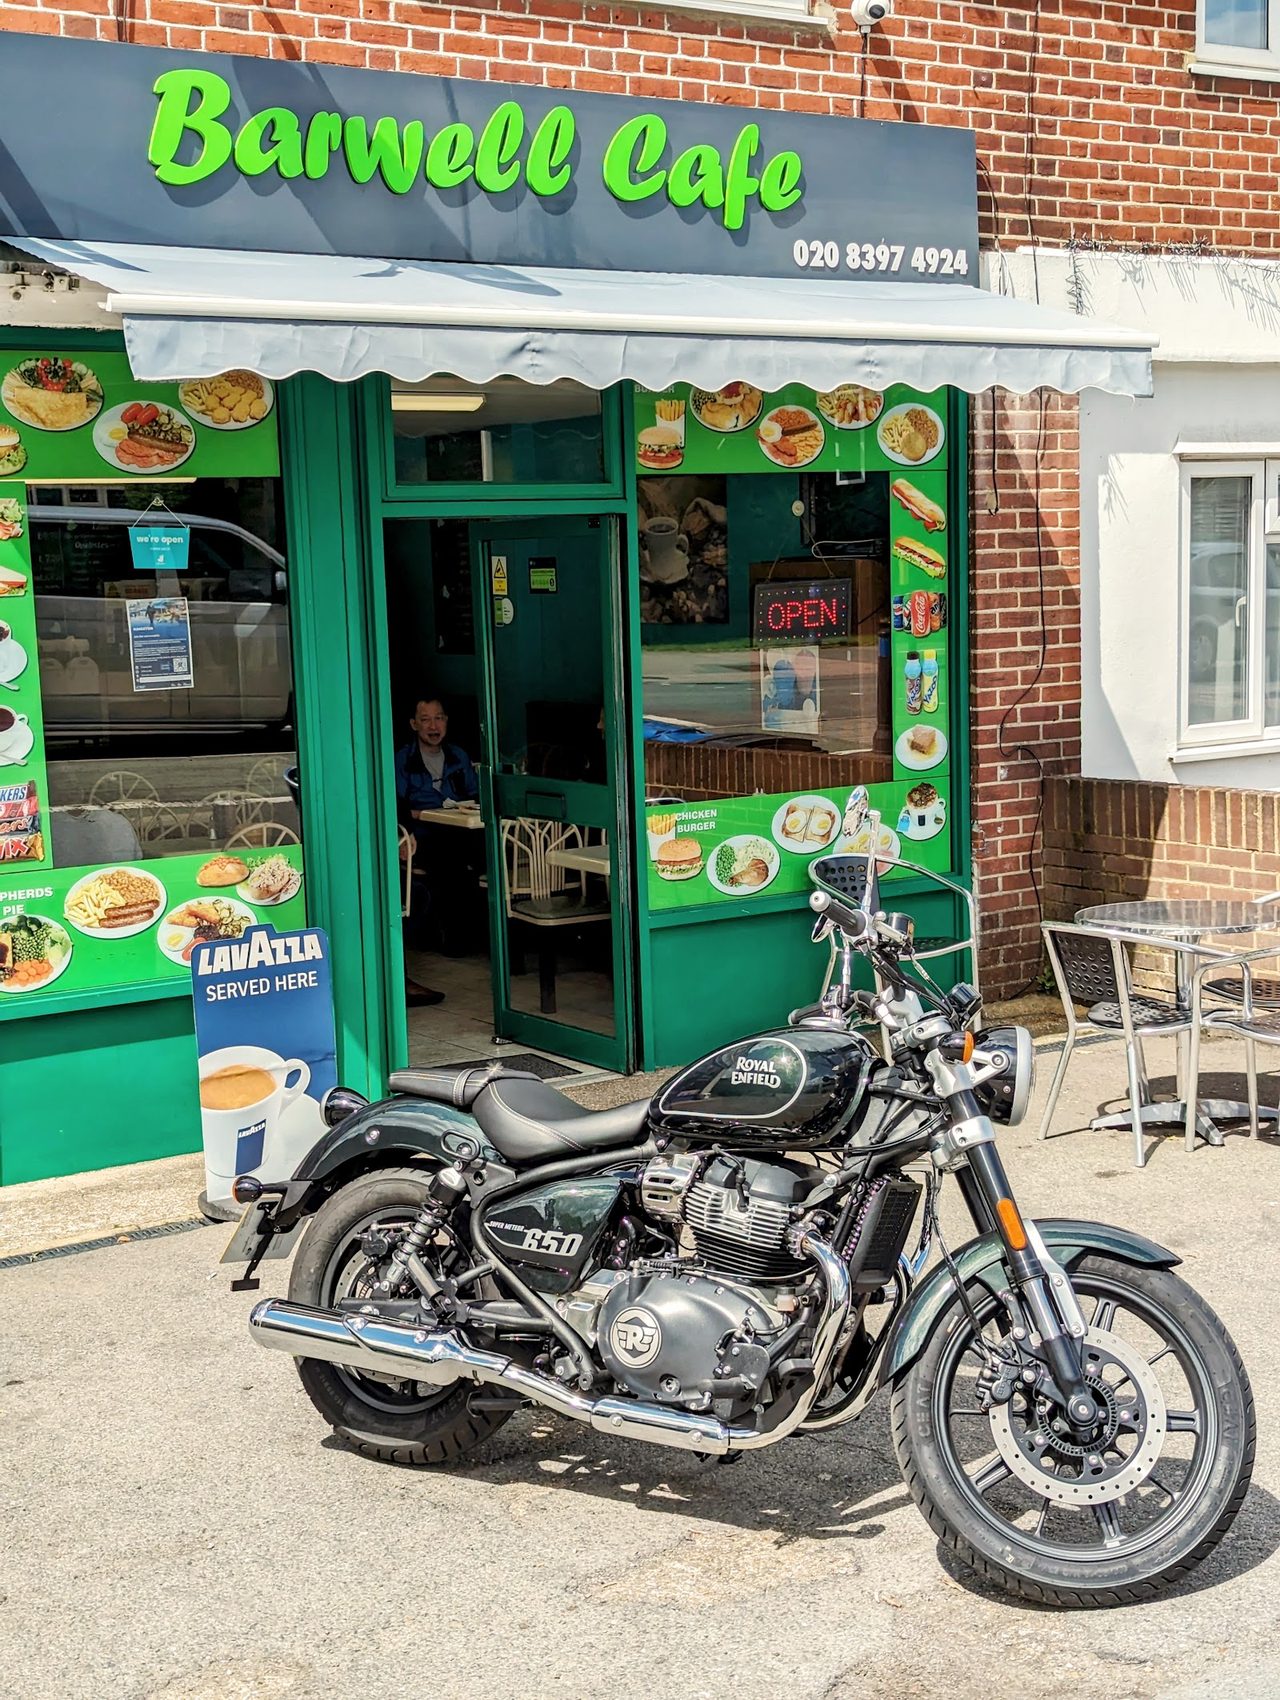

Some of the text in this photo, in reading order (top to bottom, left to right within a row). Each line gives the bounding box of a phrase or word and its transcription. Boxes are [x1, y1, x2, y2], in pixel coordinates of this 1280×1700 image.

[148, 69, 803, 231] Barwell Cafe
[793, 239, 969, 275] 020 8397 4924
[136, 534, 184, 546] we're open
[767, 598, 838, 630] OPEN
[676, 809, 718, 821] CHICKEN
[677, 821, 716, 833] BURGER
[3, 904, 25, 916] PIE
[198, 930, 324, 976] LAVAZZA
[206, 970, 319, 1002] SERVED HERE
[735, 1056, 777, 1073] ROYAL
[731, 1071, 782, 1089] ENFIELD
[489, 1220, 584, 1257] SUPER METEOR 650
